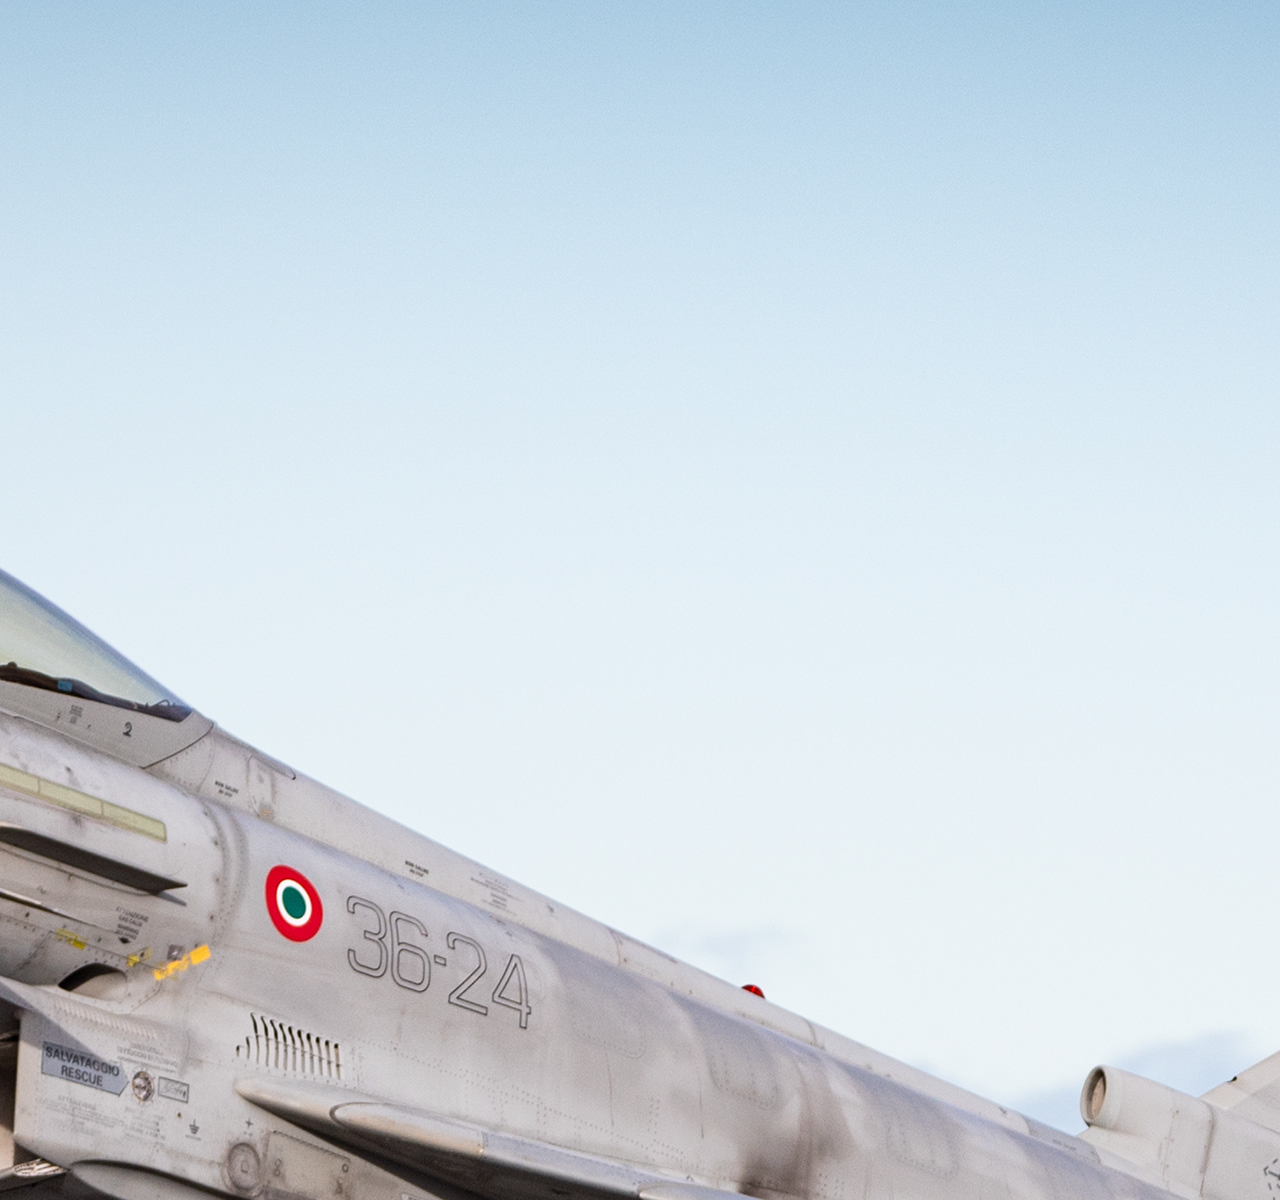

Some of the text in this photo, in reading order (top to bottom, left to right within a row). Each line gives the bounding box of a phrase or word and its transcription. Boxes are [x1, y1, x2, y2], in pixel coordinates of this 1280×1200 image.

[122, 721, 133, 737] 2
[346, 895, 532, 1030] 36-24
[45, 1045, 120, 1077] SALVATAGGIO
[61, 1065, 103, 1087] RESCUE
